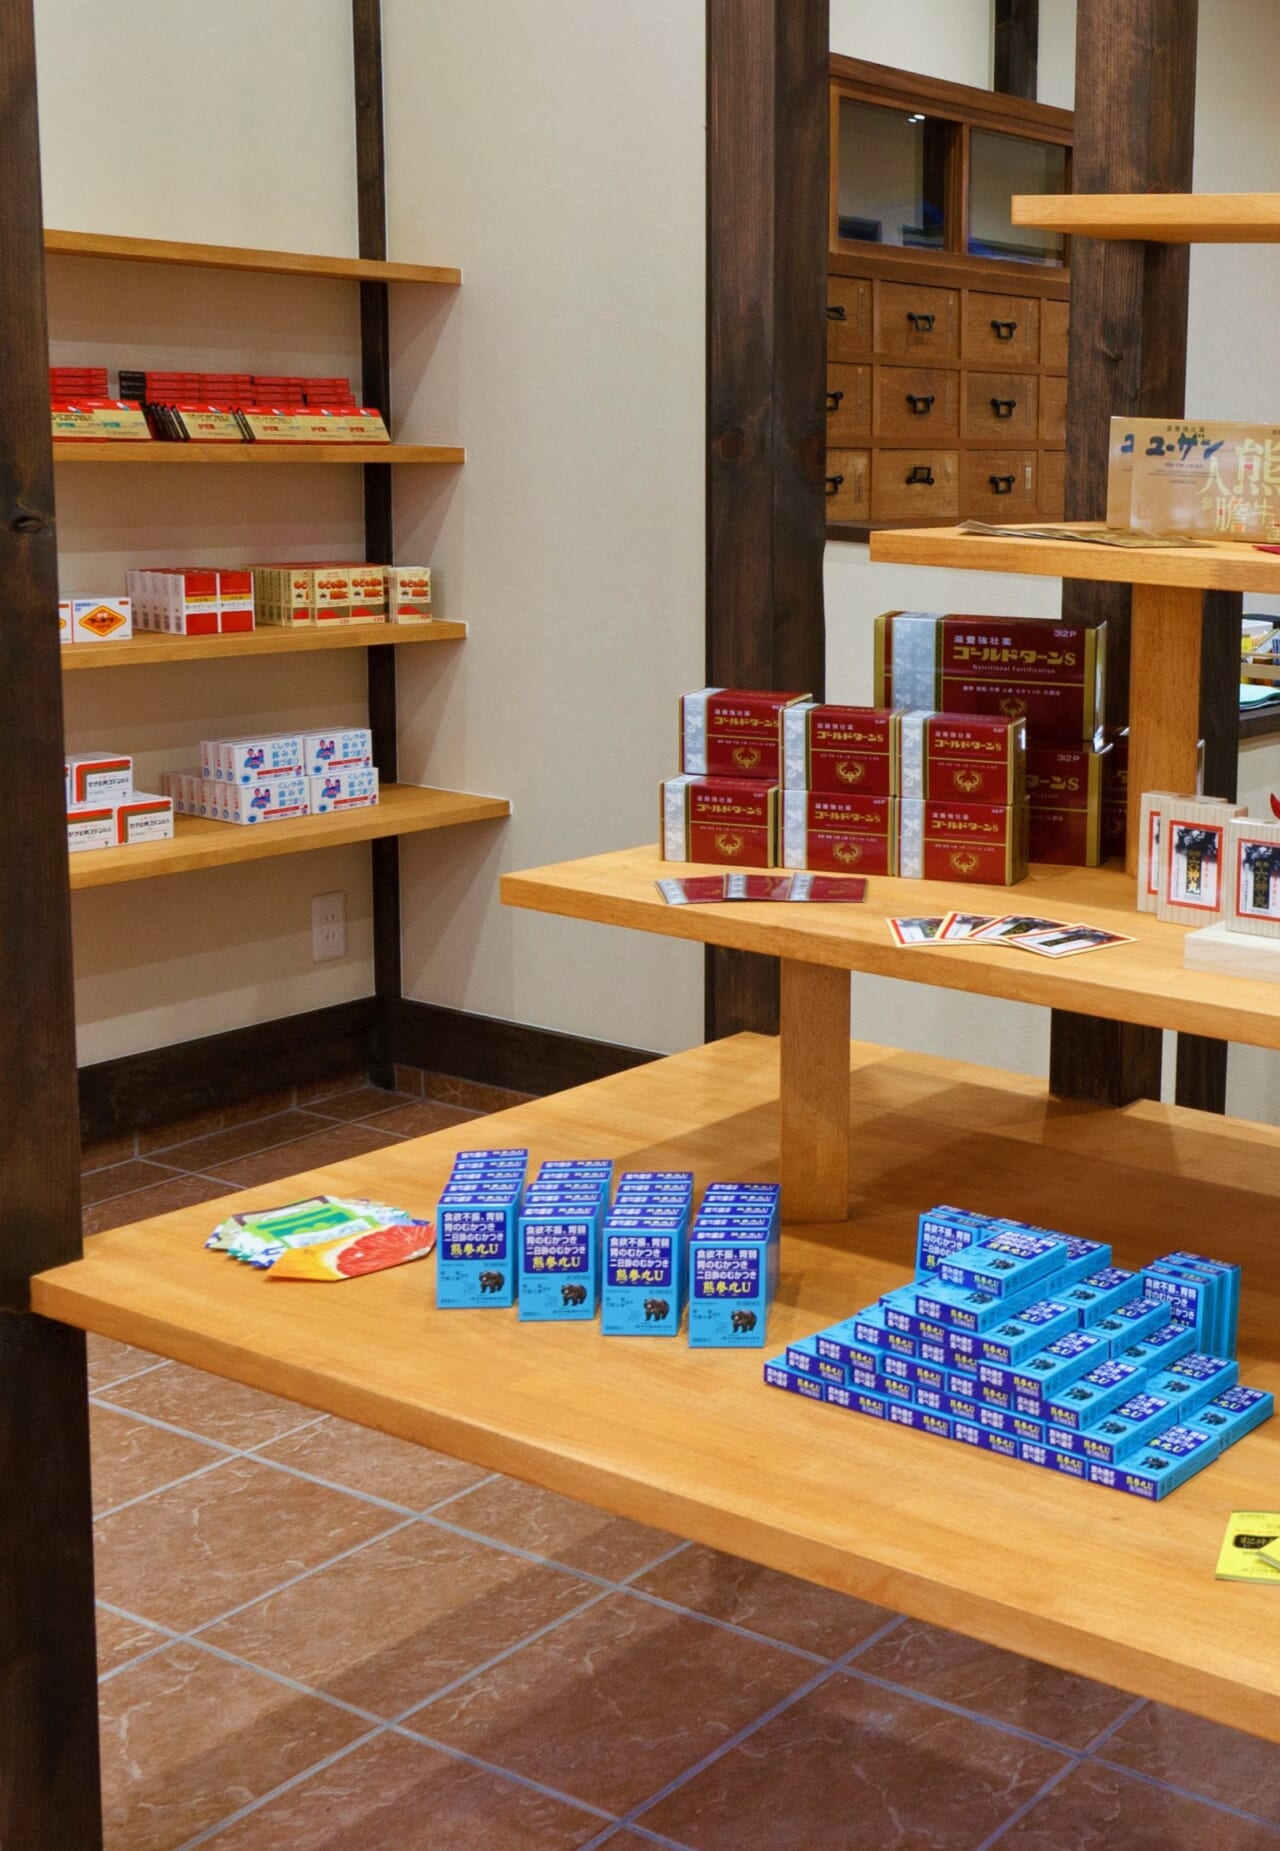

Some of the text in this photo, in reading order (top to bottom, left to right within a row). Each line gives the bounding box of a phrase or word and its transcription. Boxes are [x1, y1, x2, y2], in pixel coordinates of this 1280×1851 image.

[953, 646, 1076, 666] ゴールドターンS
